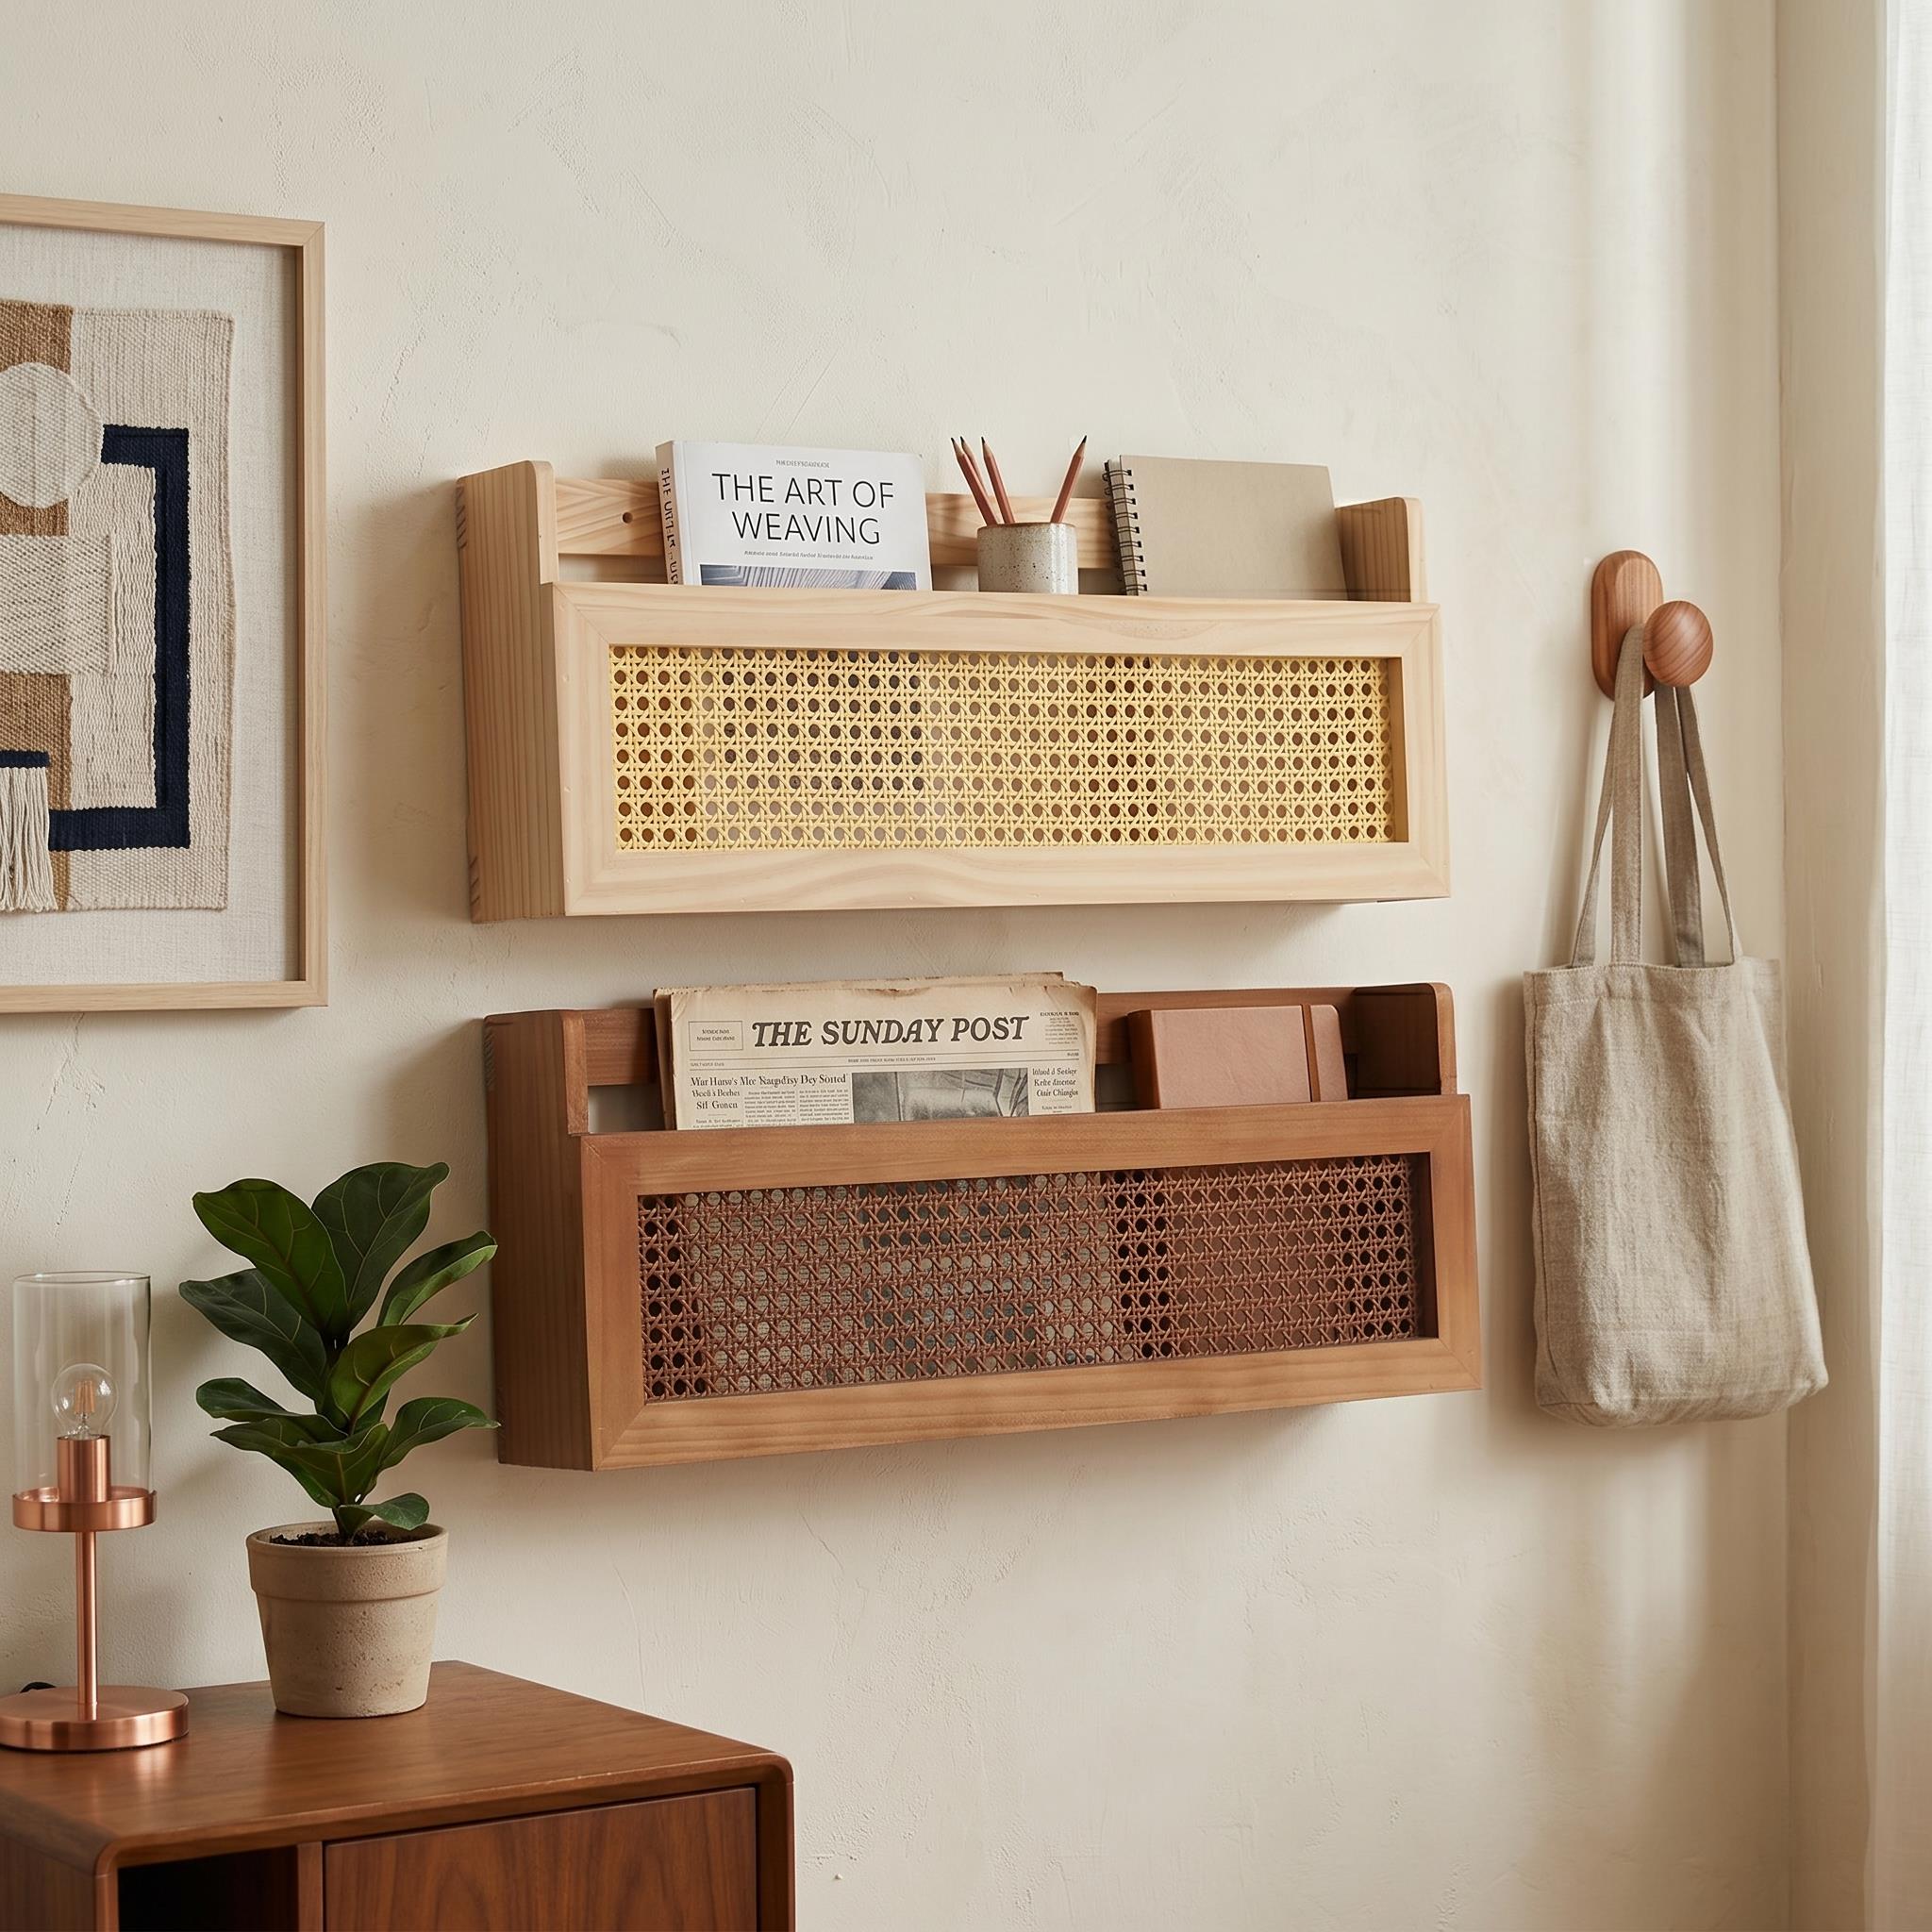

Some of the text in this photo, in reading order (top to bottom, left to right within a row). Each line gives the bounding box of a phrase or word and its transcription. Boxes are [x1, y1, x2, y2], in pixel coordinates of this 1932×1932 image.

[712, 474, 893, 508] THE ART OF
[732, 512, 879, 544] WEAVING
[752, 1022, 811, 1047] THE
[822, 1019, 944, 1044] SUNDAY
[950, 1016, 1029, 1041] POST
